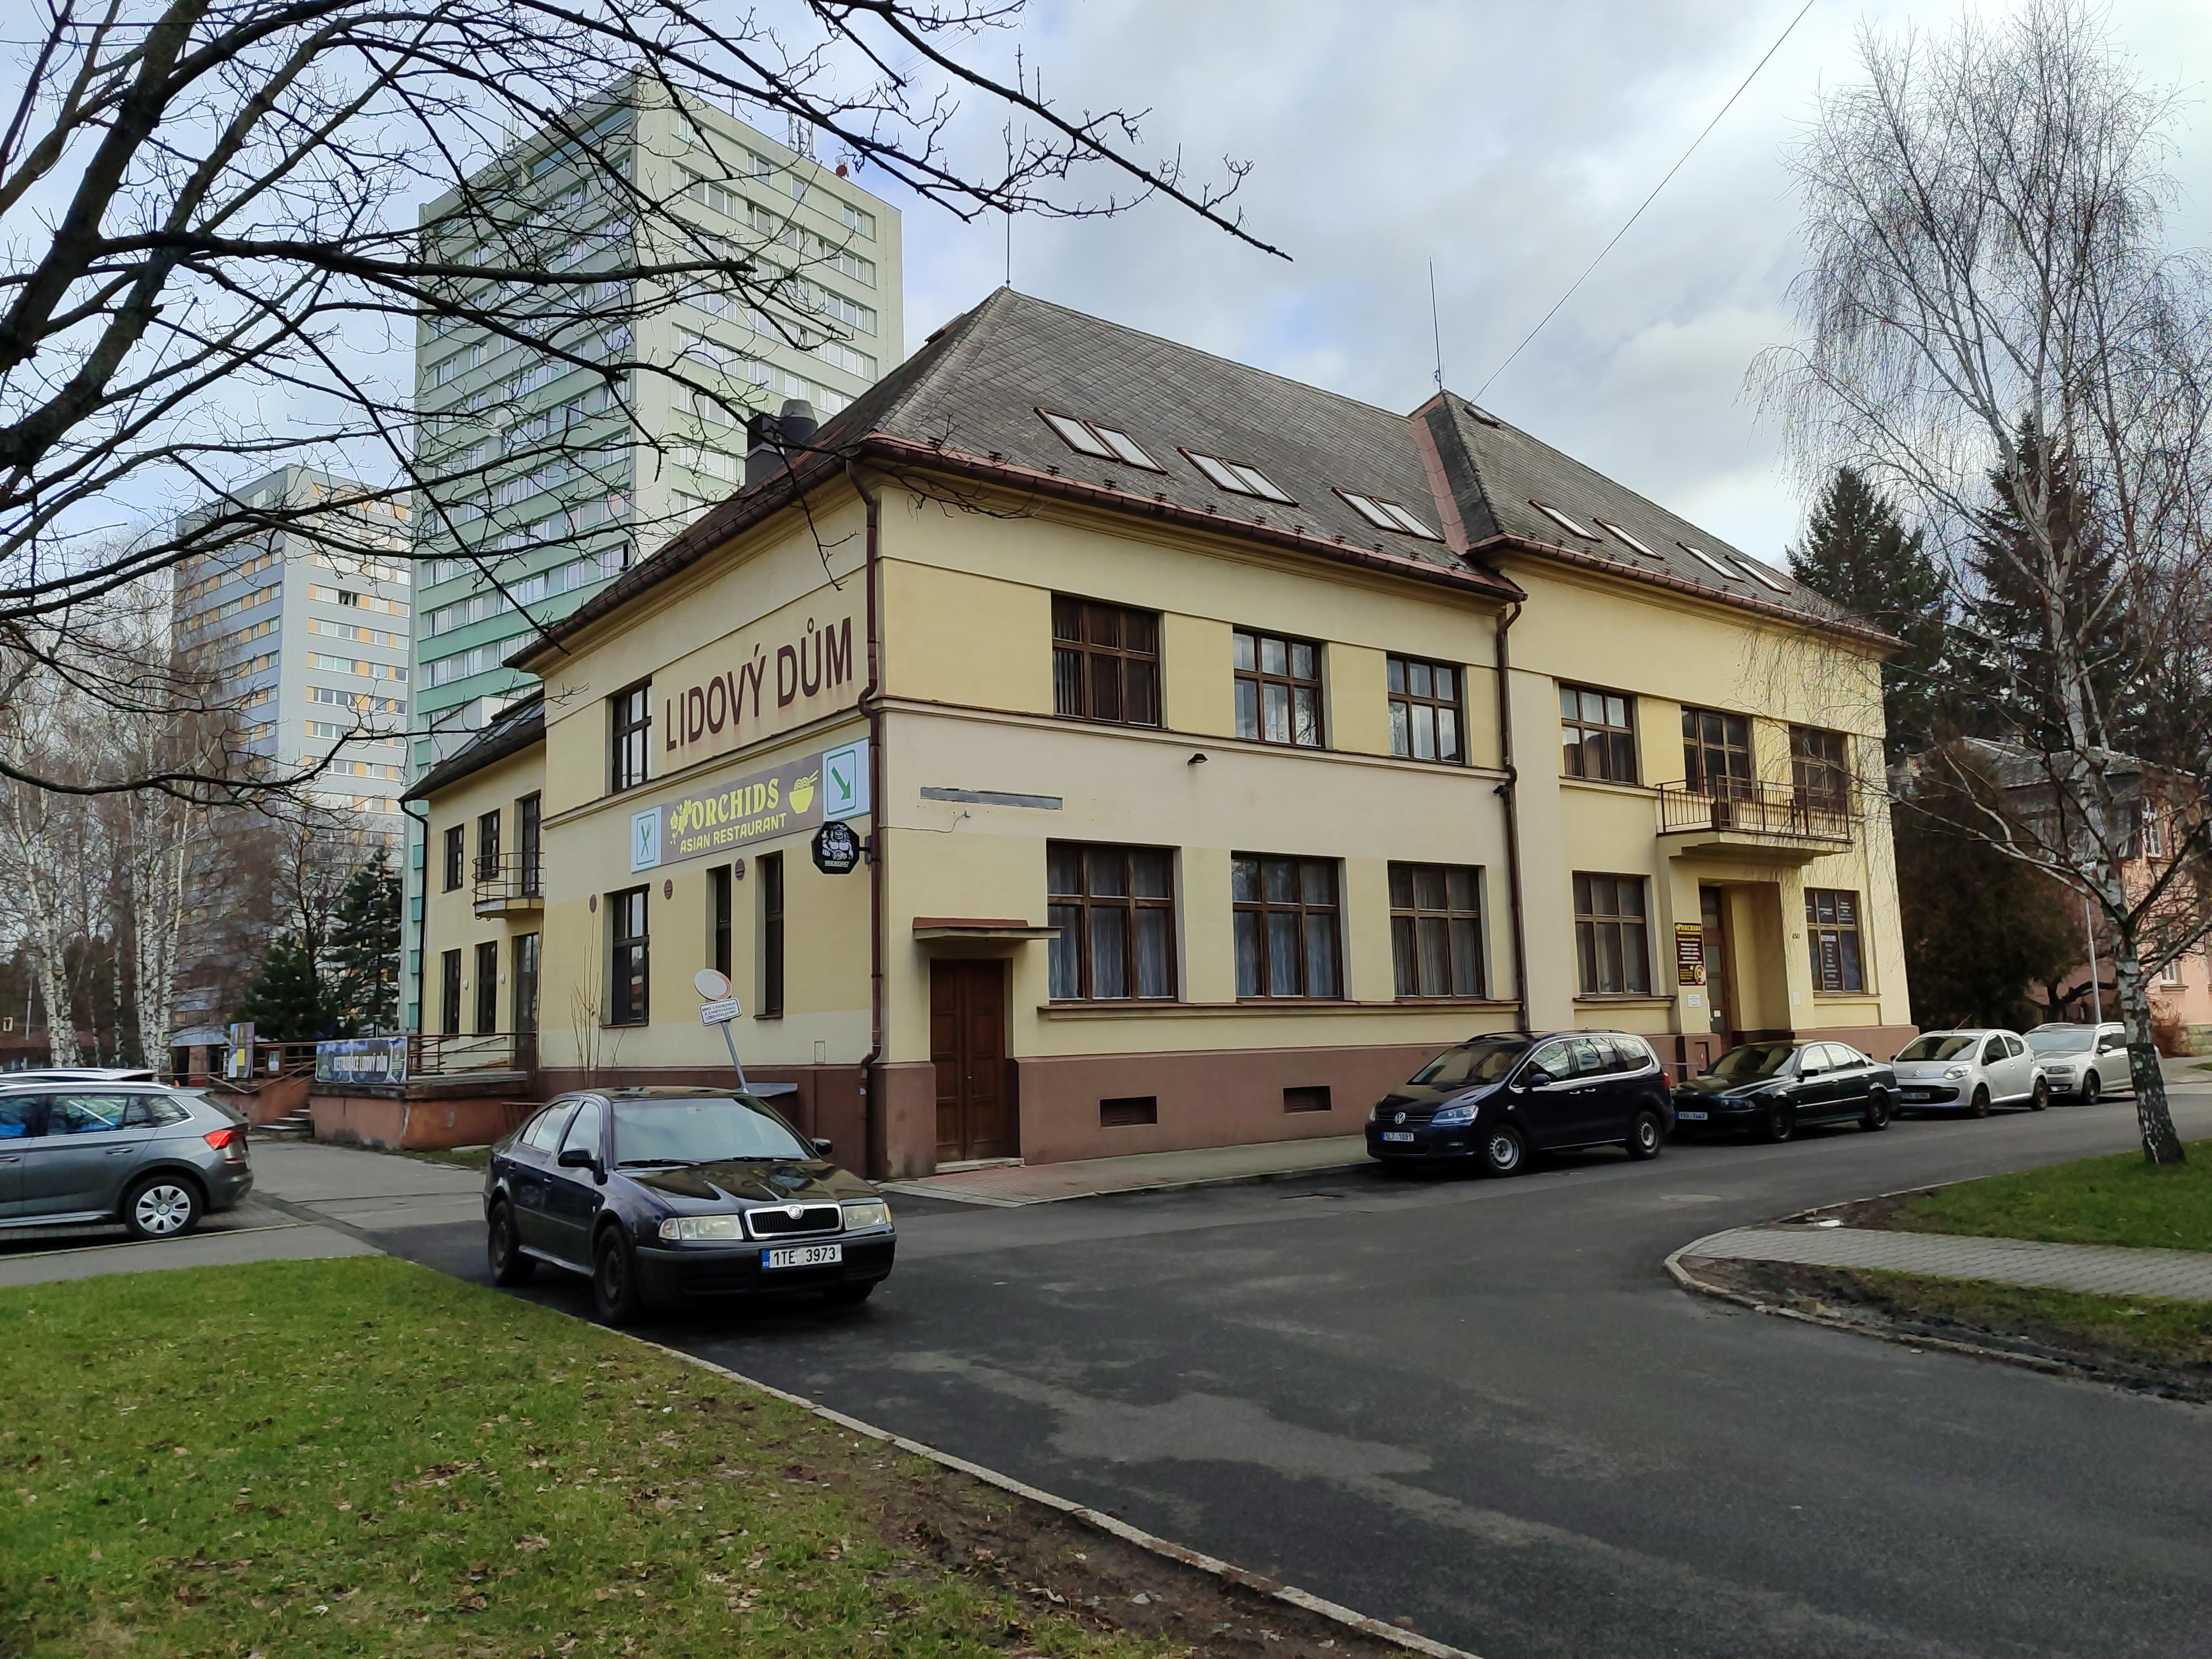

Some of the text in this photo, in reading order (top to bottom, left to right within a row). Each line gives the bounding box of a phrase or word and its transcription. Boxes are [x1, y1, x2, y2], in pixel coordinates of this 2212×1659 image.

[666, 616, 852, 753] LIDOVÝ DŮM
[691, 778, 779, 830] ORCHIDS
[680, 812, 787, 854] ASIAN RESTAURANT
[774, 1246, 836, 1265] 1TE 3973
